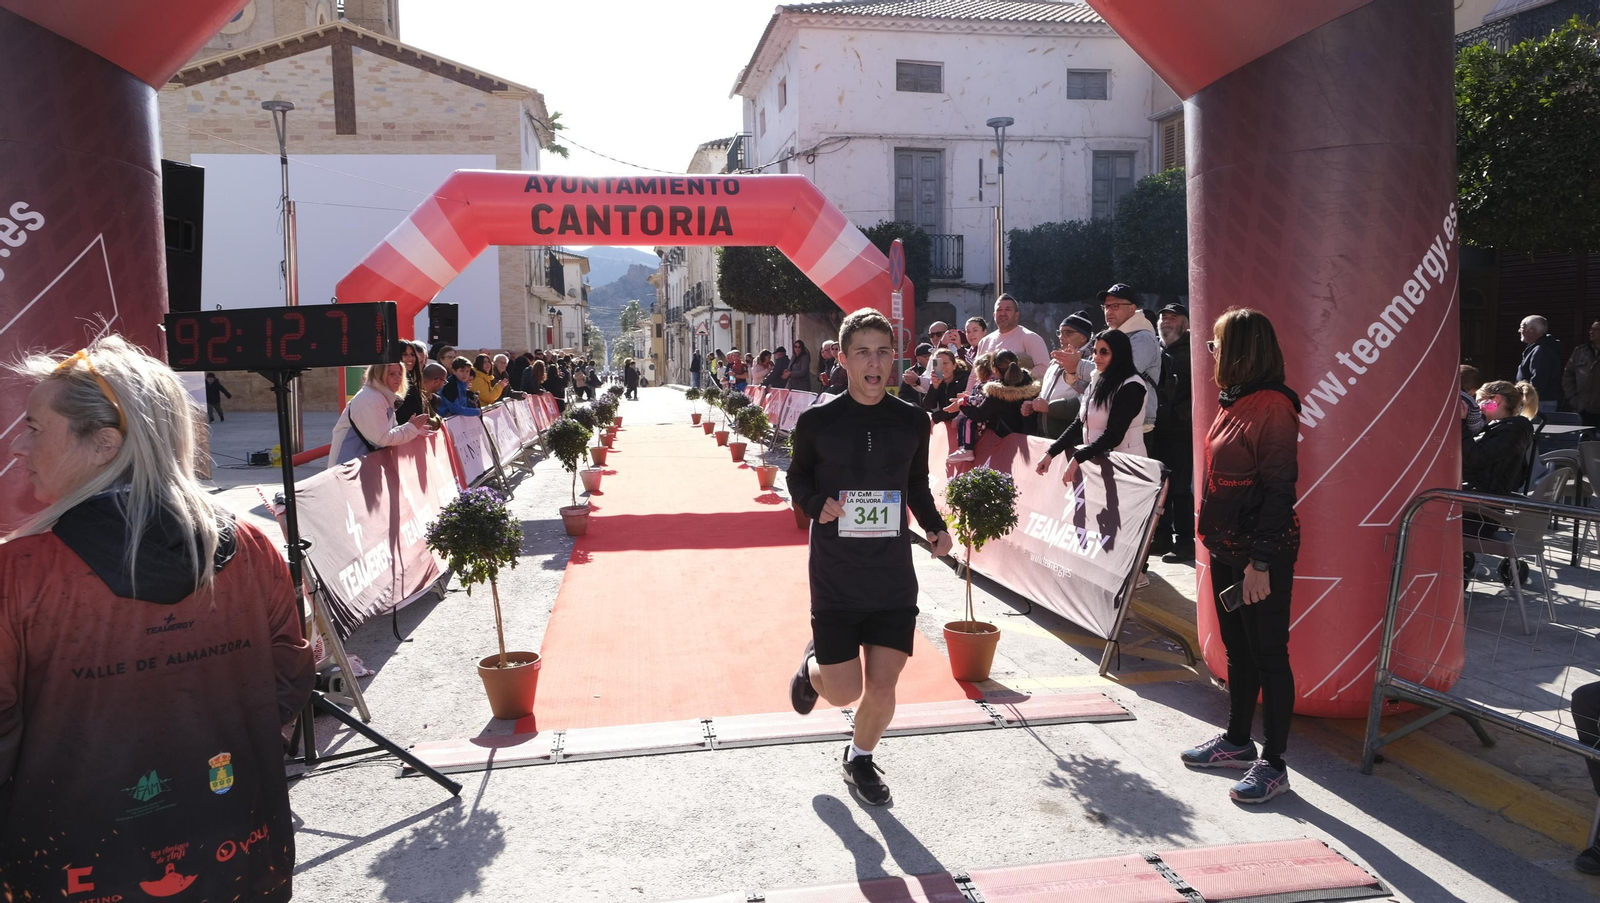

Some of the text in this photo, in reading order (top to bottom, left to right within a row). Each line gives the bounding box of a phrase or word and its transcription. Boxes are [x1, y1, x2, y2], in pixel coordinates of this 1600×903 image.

[524, 175, 740, 195] AYUNTAMIENTO
[531, 203, 733, 236] CANTORIA
[1297, 202, 1458, 443] ww.teamergy.es
[854, 506, 888, 525] 341
[1023, 512, 1111, 559] TEAMERGY
[145, 620, 195, 635] TEAMERGY
[71, 638, 252, 680] VALLE DE ALMANZORA
[136, 782, 160, 801] FAM
